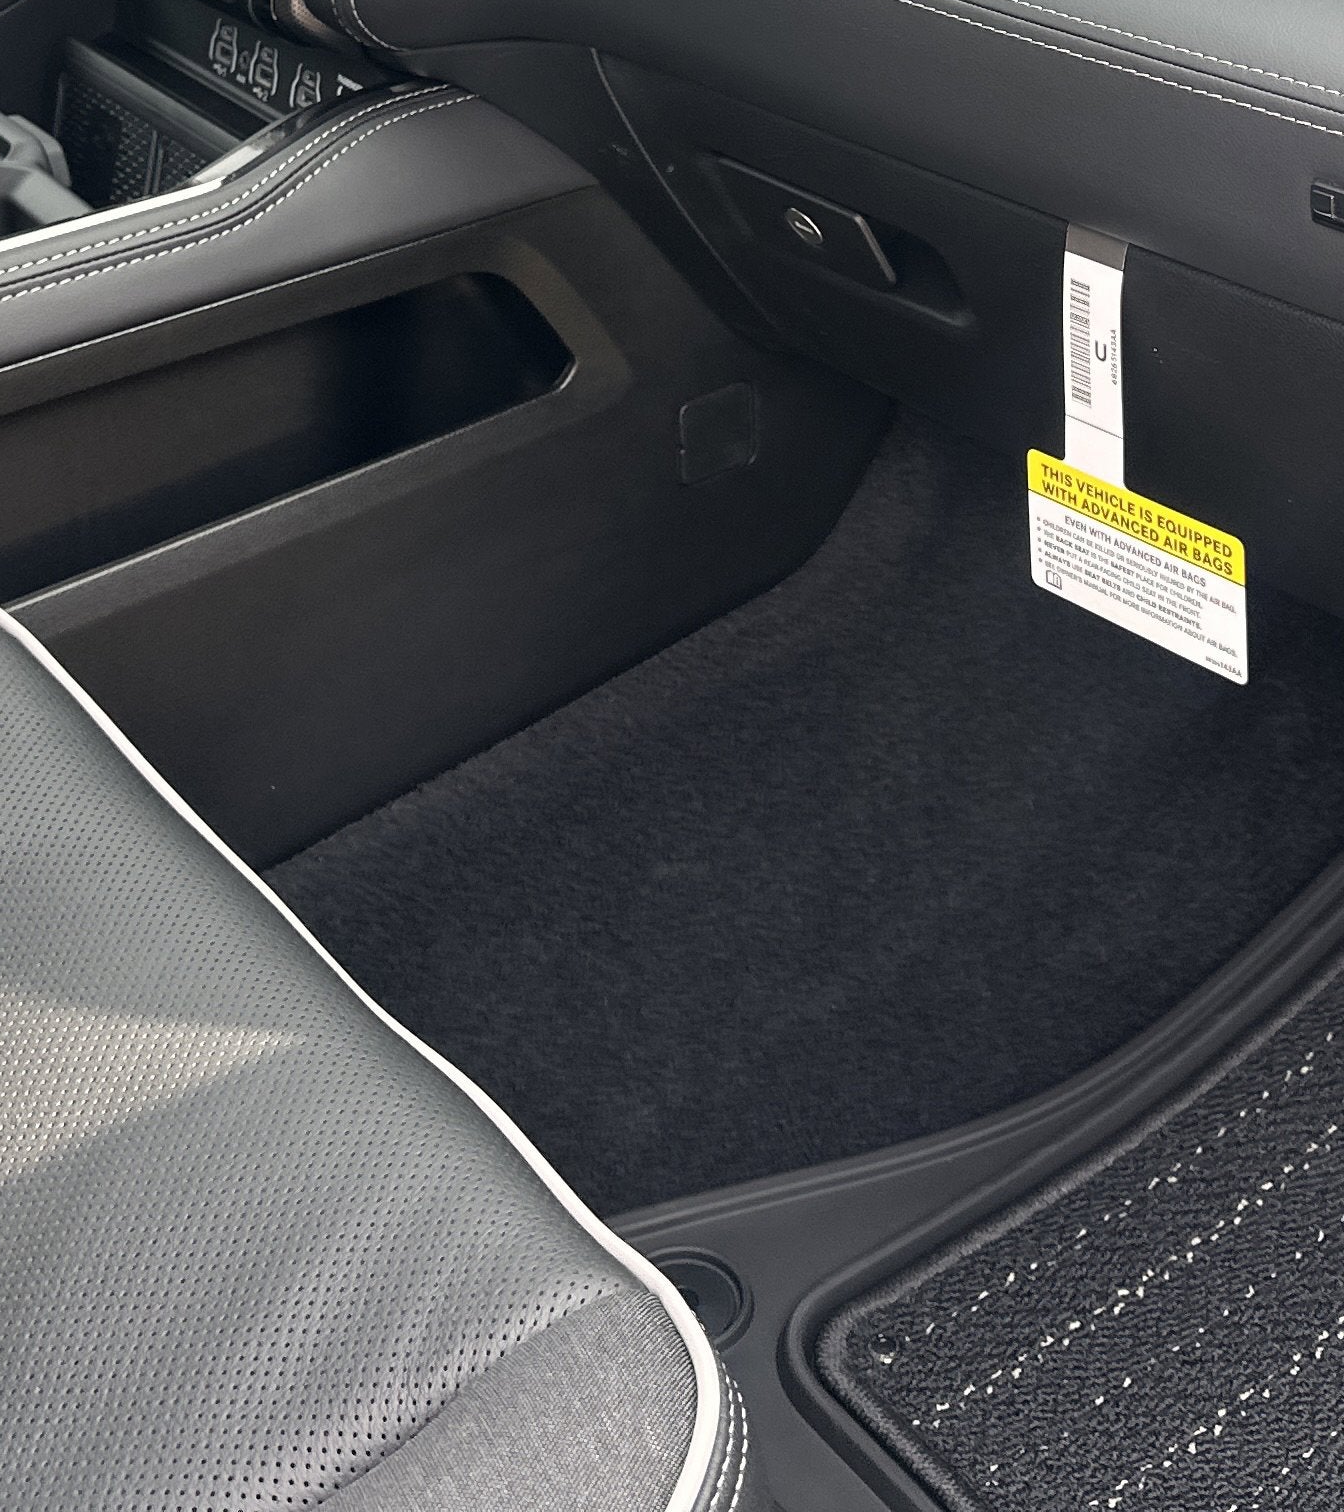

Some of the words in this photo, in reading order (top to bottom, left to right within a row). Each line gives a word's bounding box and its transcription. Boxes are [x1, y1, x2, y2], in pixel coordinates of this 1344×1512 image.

[1041, 464, 1072, 487] THIS
[1076, 479, 1134, 515] VEHICLE
[1140, 507, 1152, 523] IS
[1157, 515, 1232, 559] EQUIPPED
[1042, 480, 1077, 506] WITH
[1081, 497, 1158, 542] ADVANCED
[1162, 533, 1187, 555] AIR
[1192, 547, 1233, 576] BAGS
[1065, 514, 1086, 533] EVEN
[1089, 526, 1111, 545] WITH
[1113, 537, 1161, 568] ADVANCED
[1163, 560, 1178, 576] AIR
[1181, 568, 1206, 588] BAGS
